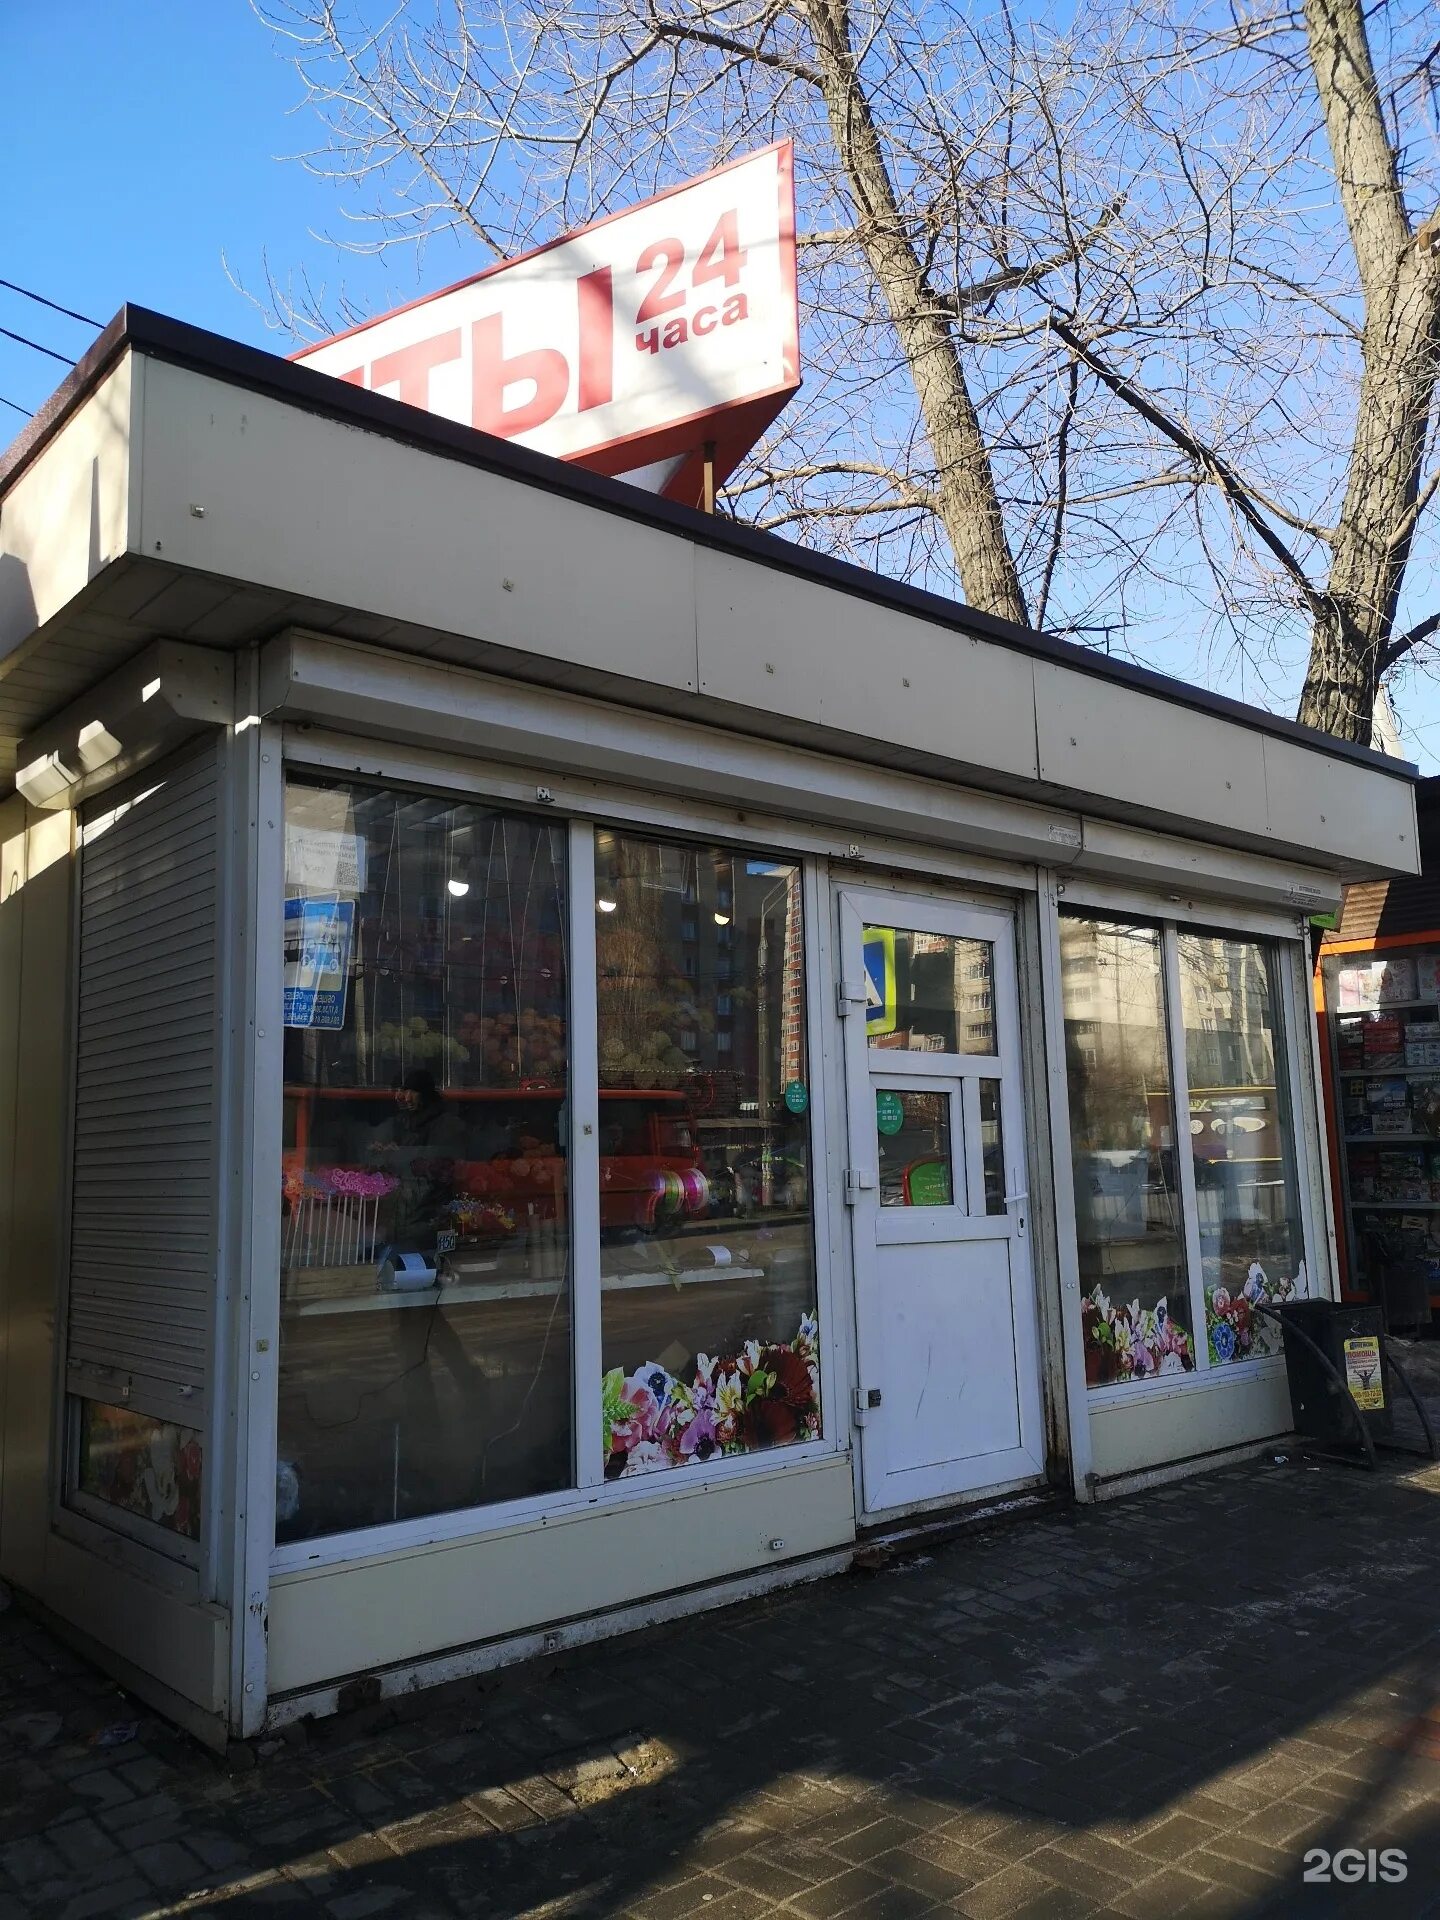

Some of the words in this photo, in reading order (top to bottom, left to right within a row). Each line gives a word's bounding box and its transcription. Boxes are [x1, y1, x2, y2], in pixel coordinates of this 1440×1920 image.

[636, 207, 748, 324] 24
[337, 265, 614, 438] ТЫ
[635, 293, 750, 355] часа
[1346, 1350, 1377, 1359] ПОМОЩЬ
